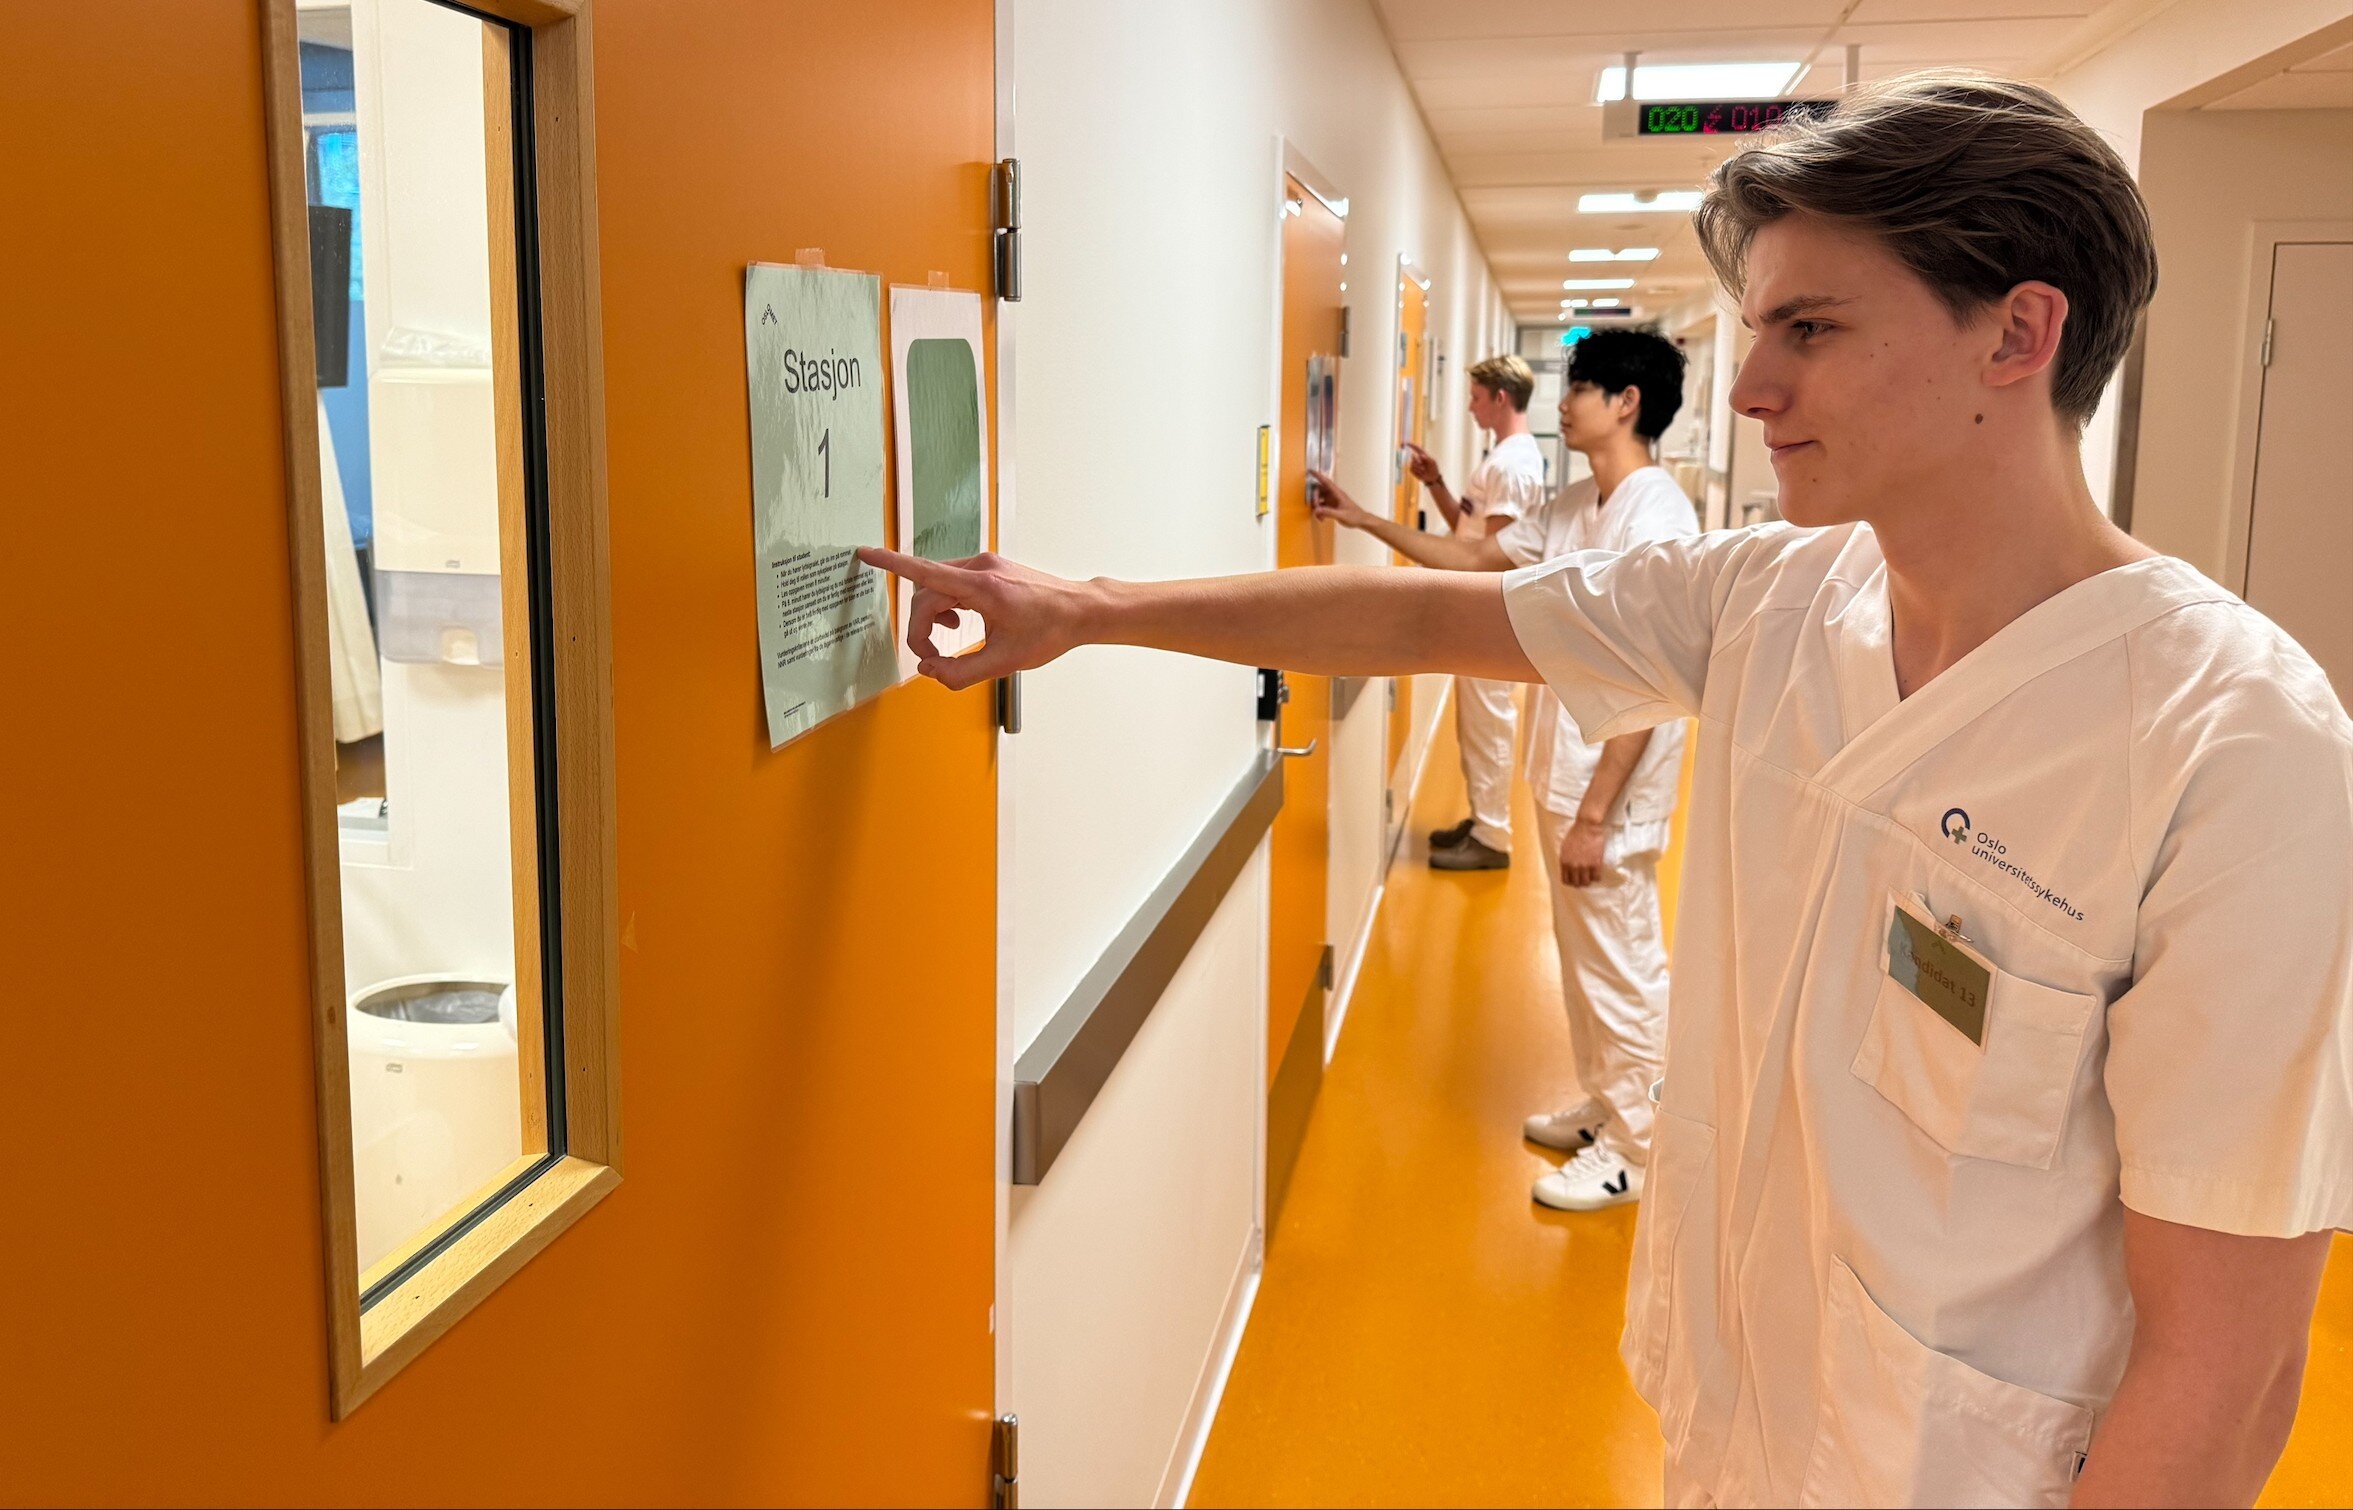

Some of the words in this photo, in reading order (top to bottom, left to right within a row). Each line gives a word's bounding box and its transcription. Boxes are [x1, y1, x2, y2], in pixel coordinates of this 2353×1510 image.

[1649, 106, 1698, 132] 020
[784, 348, 861, 400] Stasjon
[818, 428, 829, 498] 1
[1977, 832, 2007, 855] Oslo
[1971, 845, 2084, 921] universitetssykehus
[1960, 987, 1976, 1007] 13
